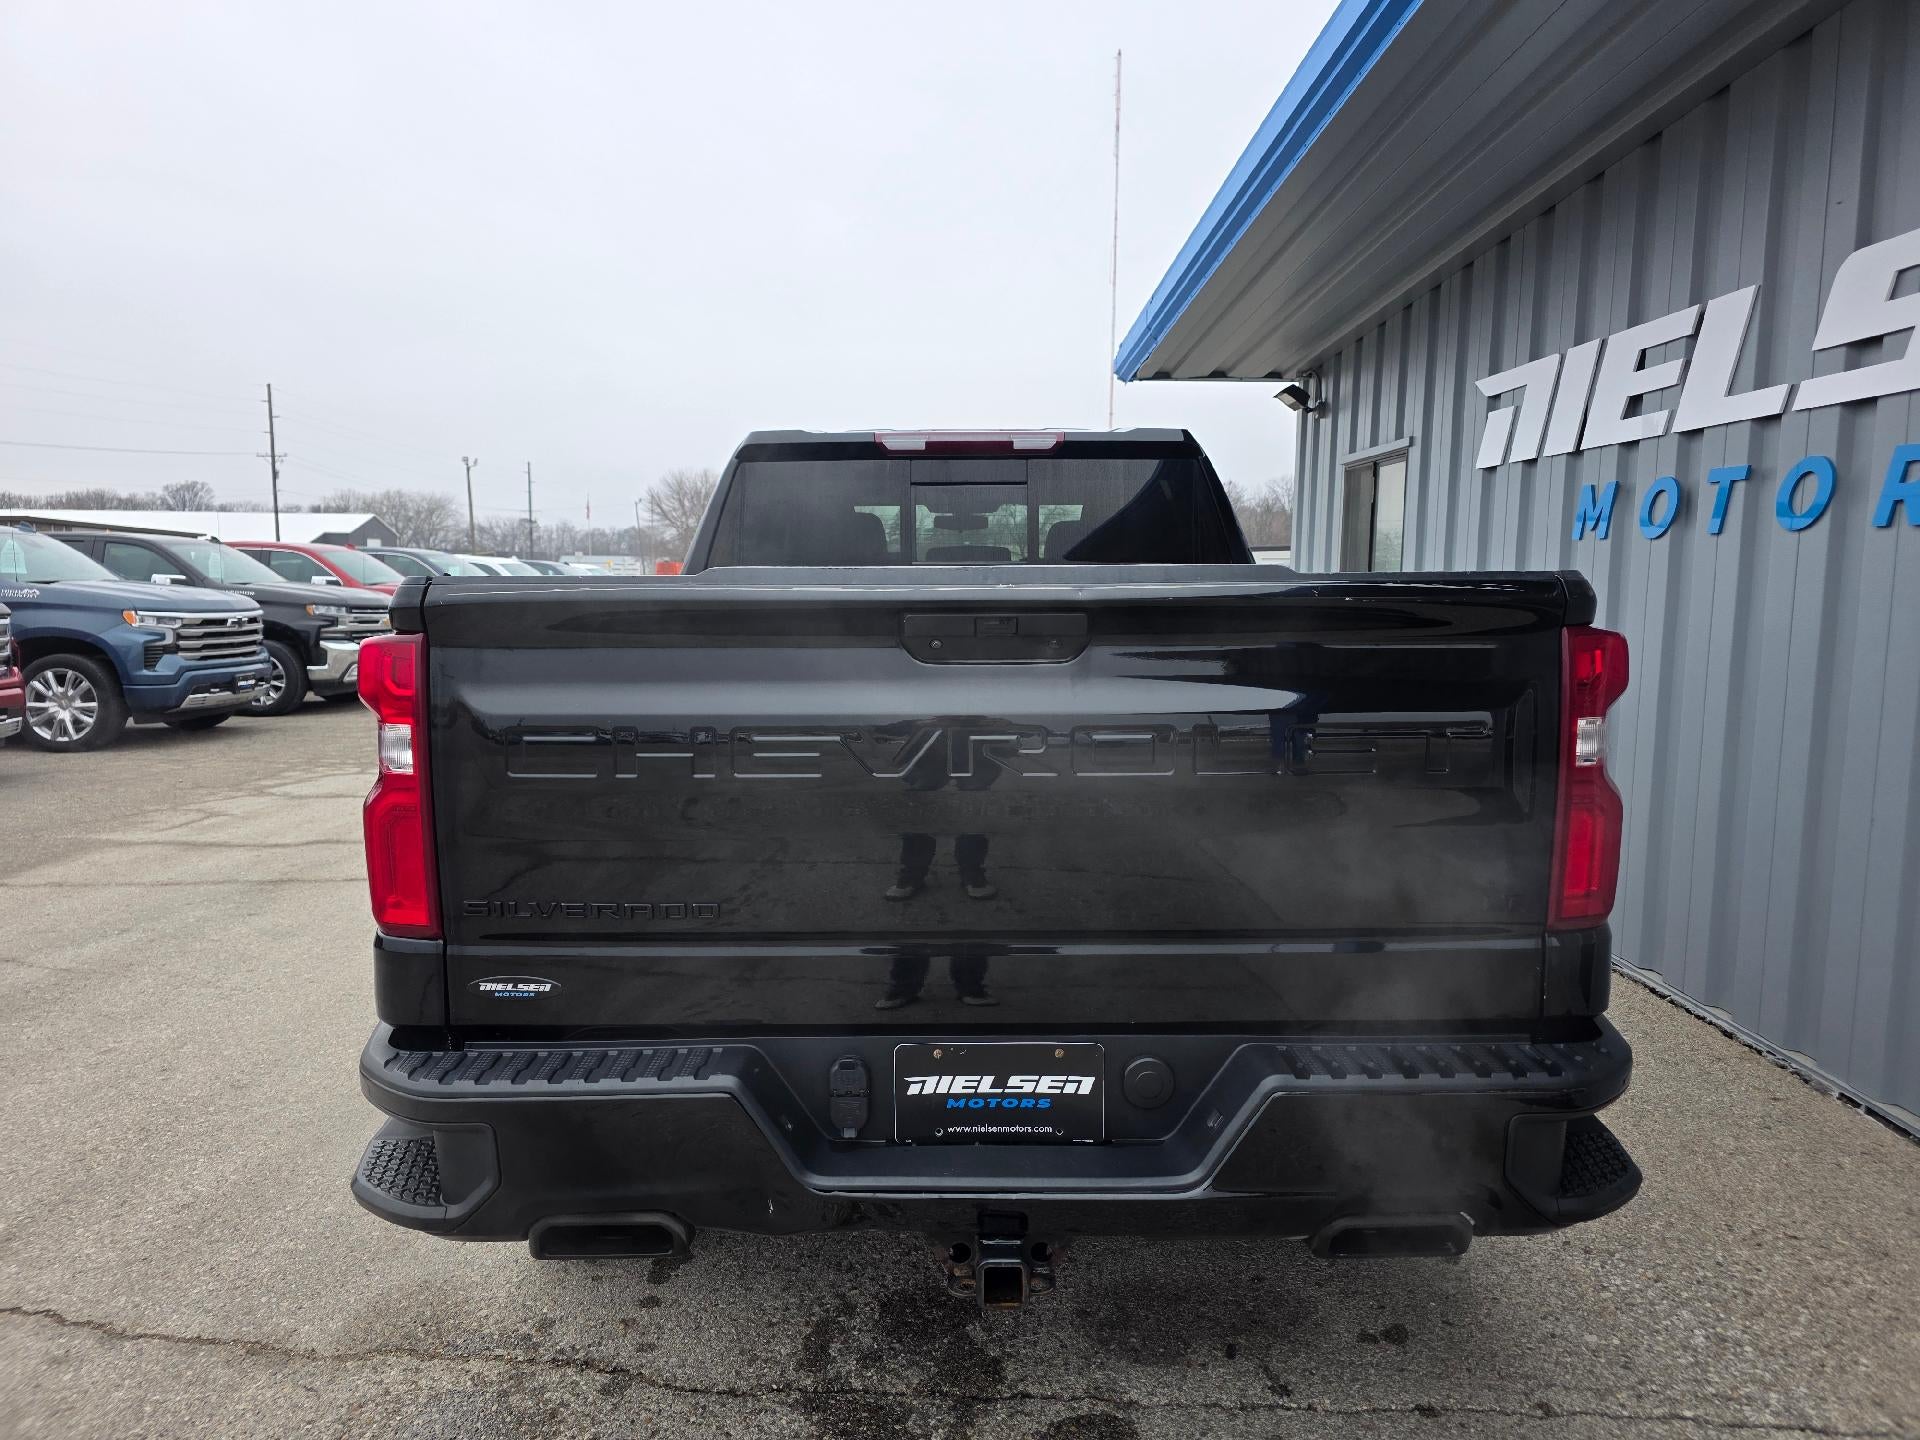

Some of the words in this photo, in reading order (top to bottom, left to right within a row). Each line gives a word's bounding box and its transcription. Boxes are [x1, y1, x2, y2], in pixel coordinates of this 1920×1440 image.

[505, 723, 1494, 779] CHEVROLET
[463, 898, 720, 919] SILVERADO
[479, 981, 552, 991] NIELSEN
[904, 1075, 1096, 1095] NIELSEN
[946, 1098, 1052, 1109] MOTORS
[947, 1124, 1053, 1134] www.nielsenmotors.com
